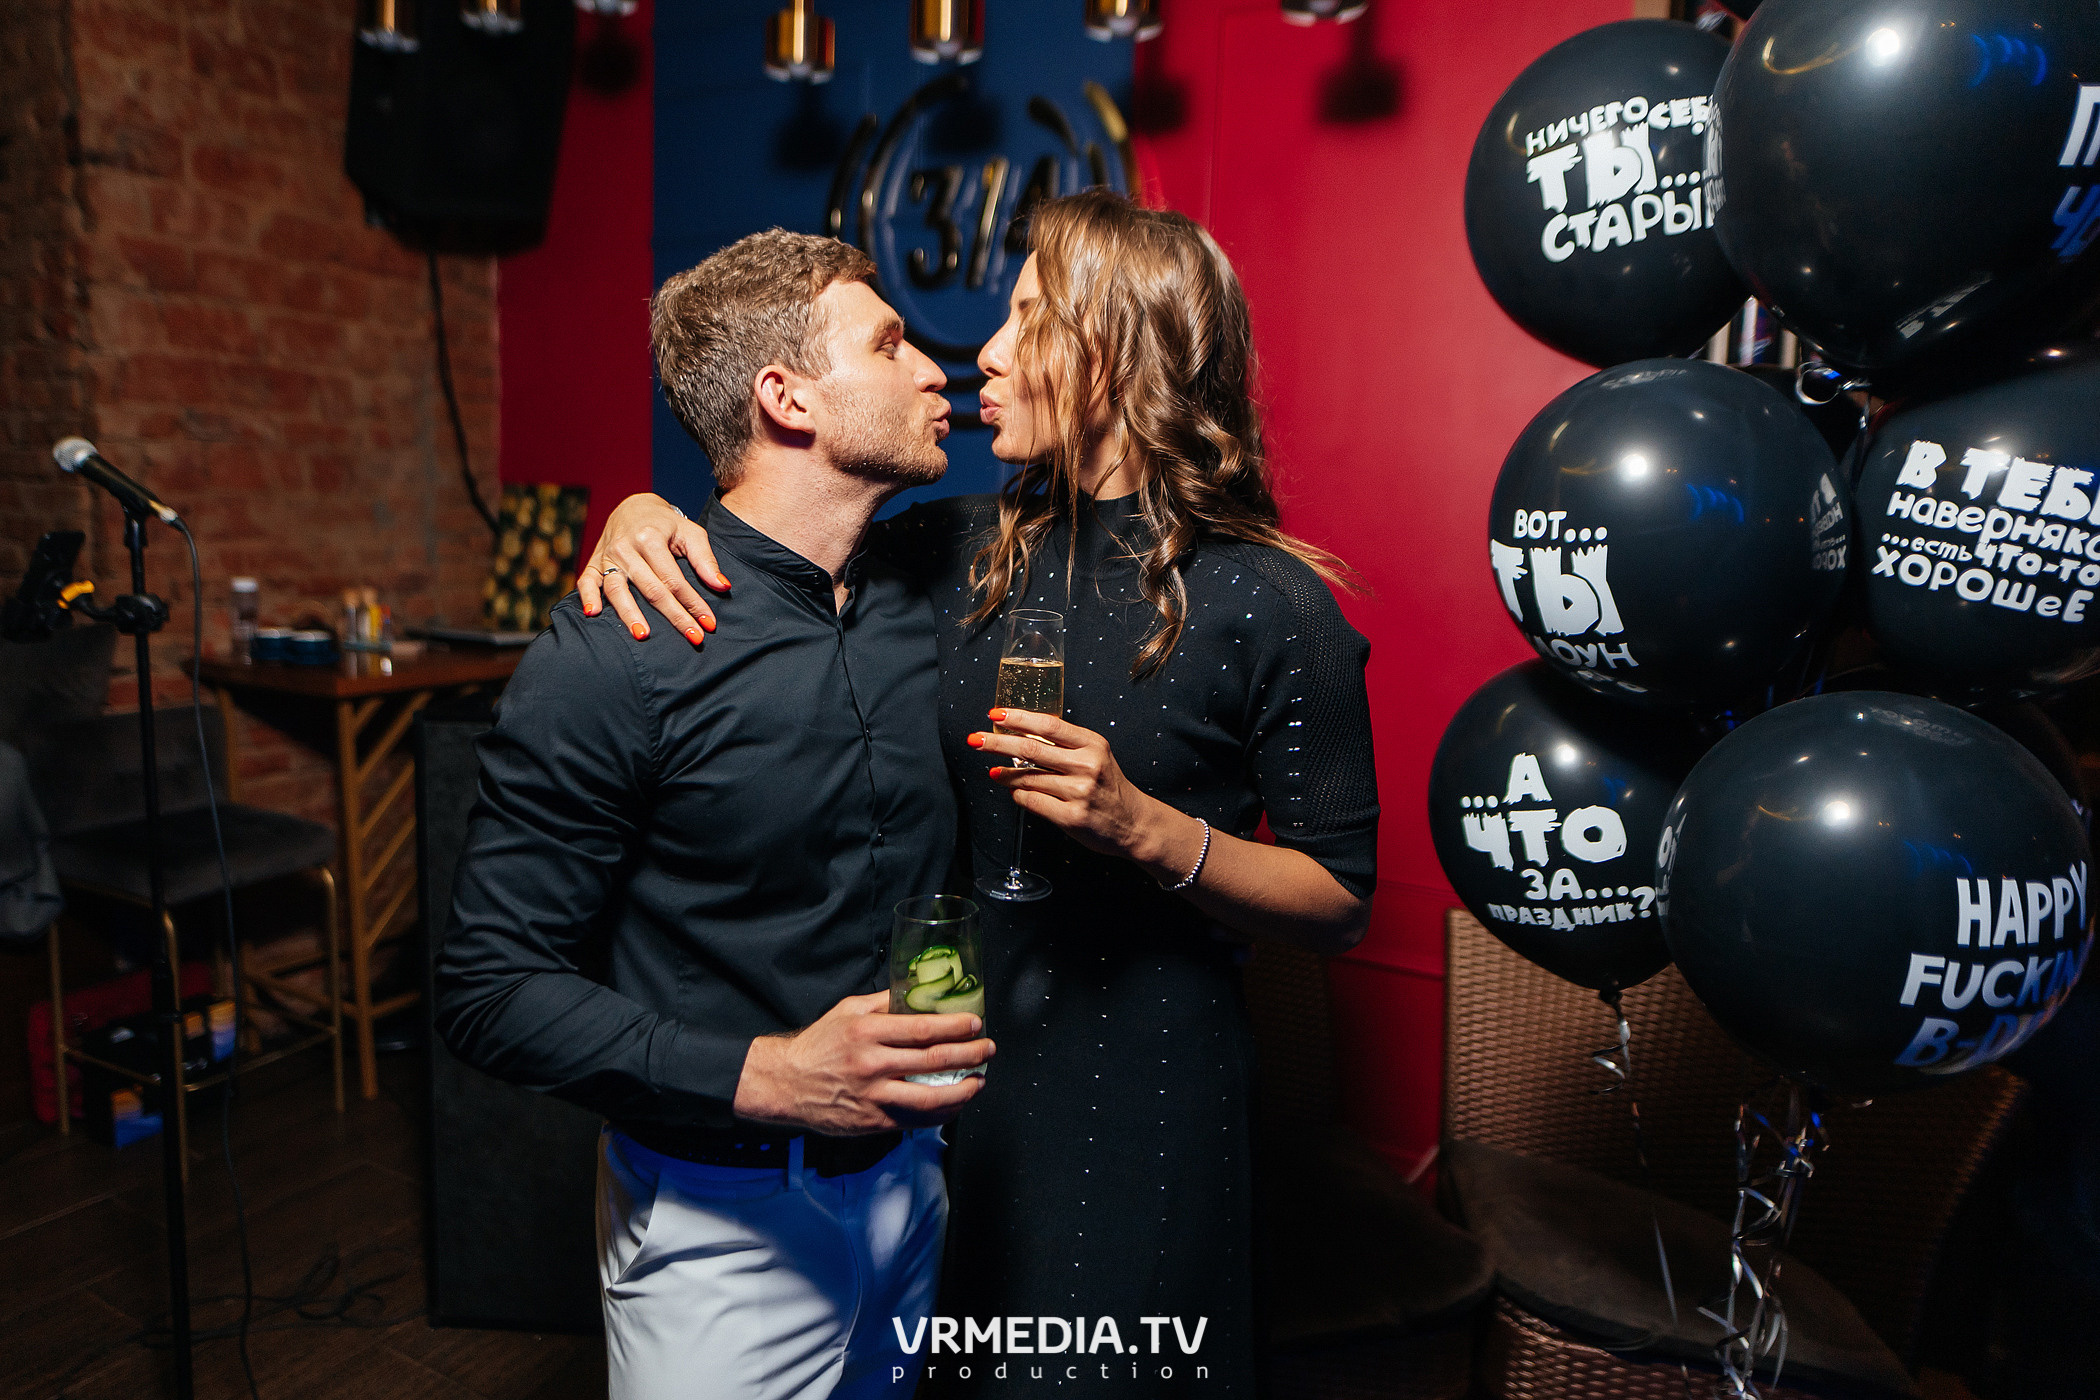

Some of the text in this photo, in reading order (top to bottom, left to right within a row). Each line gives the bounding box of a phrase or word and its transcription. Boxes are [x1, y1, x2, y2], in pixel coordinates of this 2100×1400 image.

[1525, 96, 1648, 157] НИЧЕГО
[1647, 94, 1713, 135] СЕБ
[1895, 439, 1947, 490] В
[1512, 508, 1608, 543] ВОТ...
[1490, 543, 1625, 637] ТЫ
[1462, 805, 1628, 871] ЧТО
[1956, 859, 2088, 950] HAPPY
